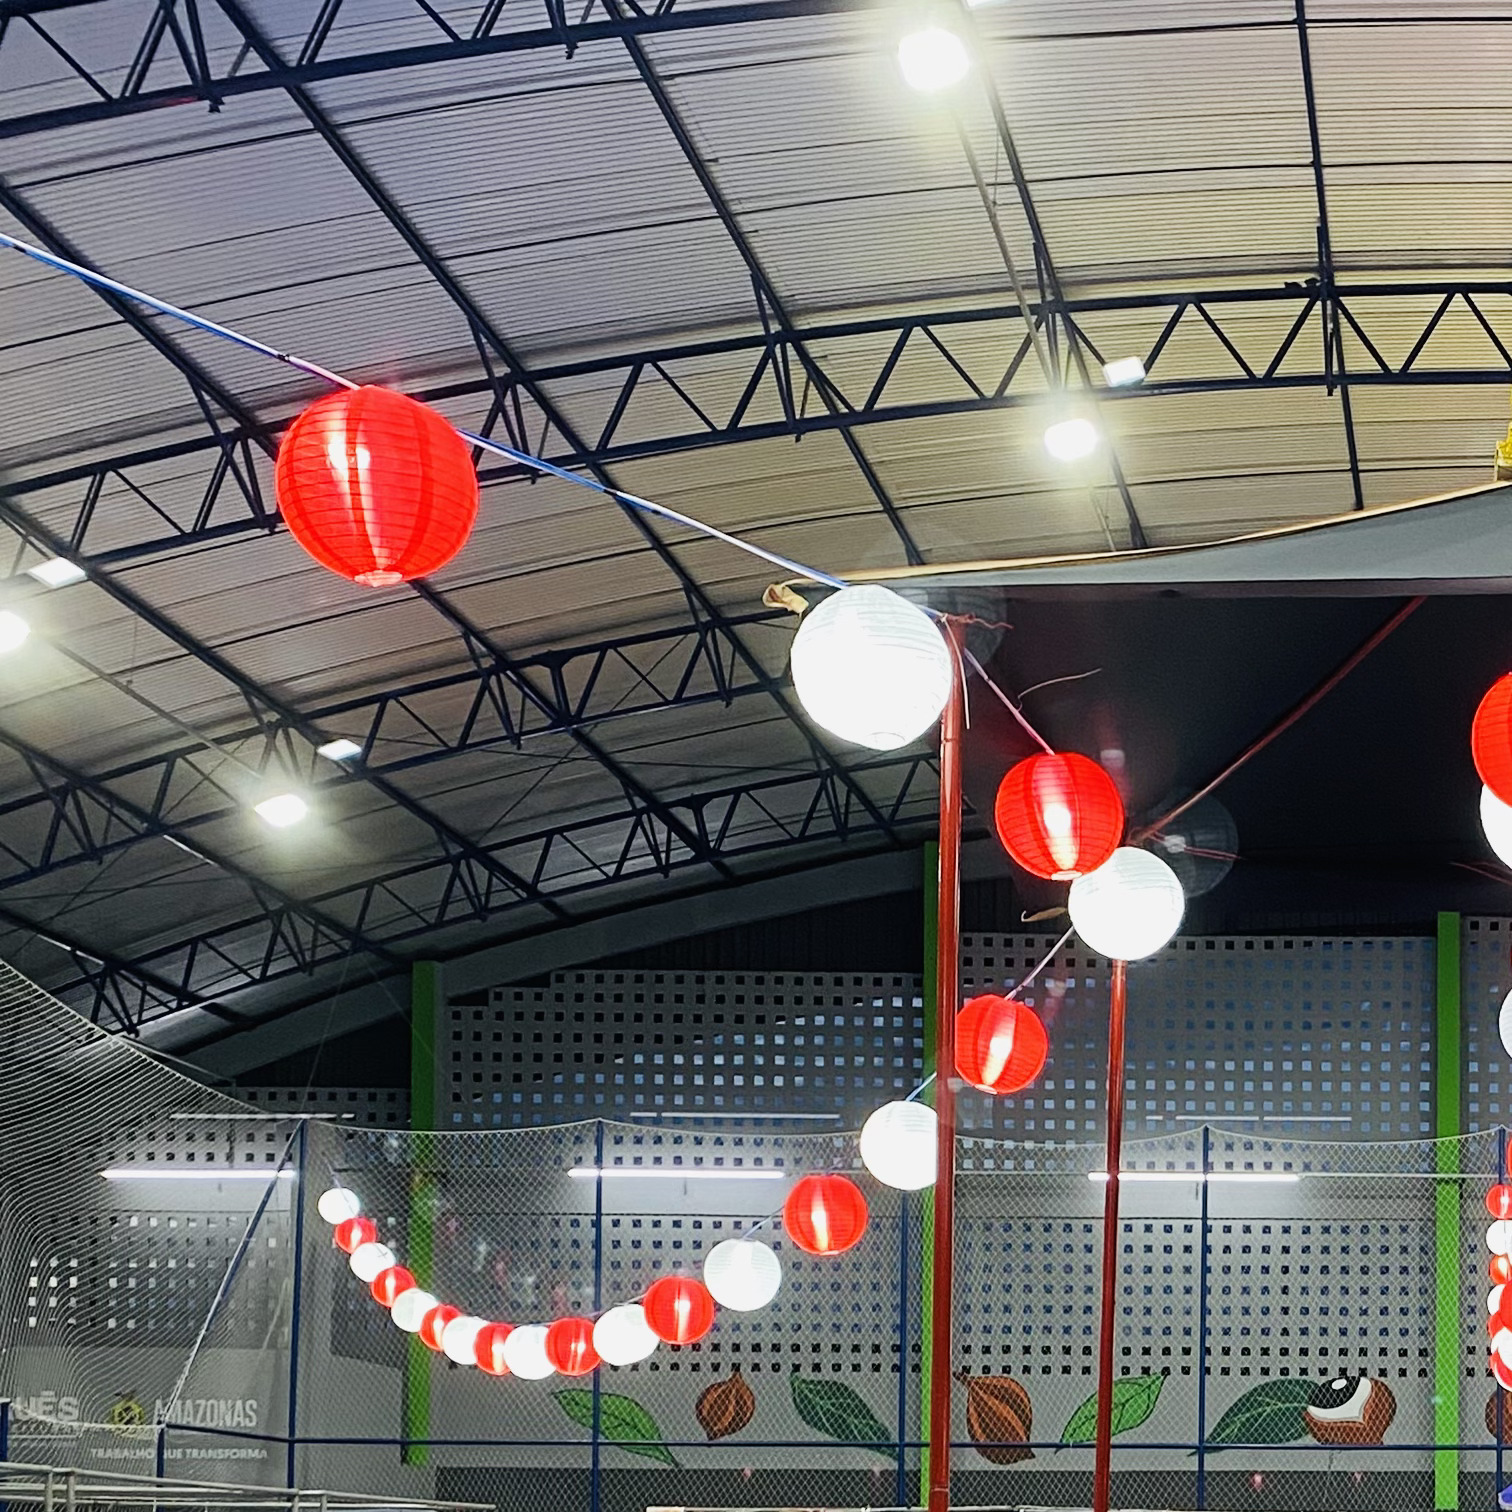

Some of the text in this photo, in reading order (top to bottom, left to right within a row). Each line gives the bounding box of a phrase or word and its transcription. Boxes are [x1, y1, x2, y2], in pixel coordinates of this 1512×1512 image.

[153, 1399, 258, 1428] AMAZONAS
[91, 1448, 156, 1459] TRABALHO
[186, 1448, 268, 1459] TRANSFORMA
